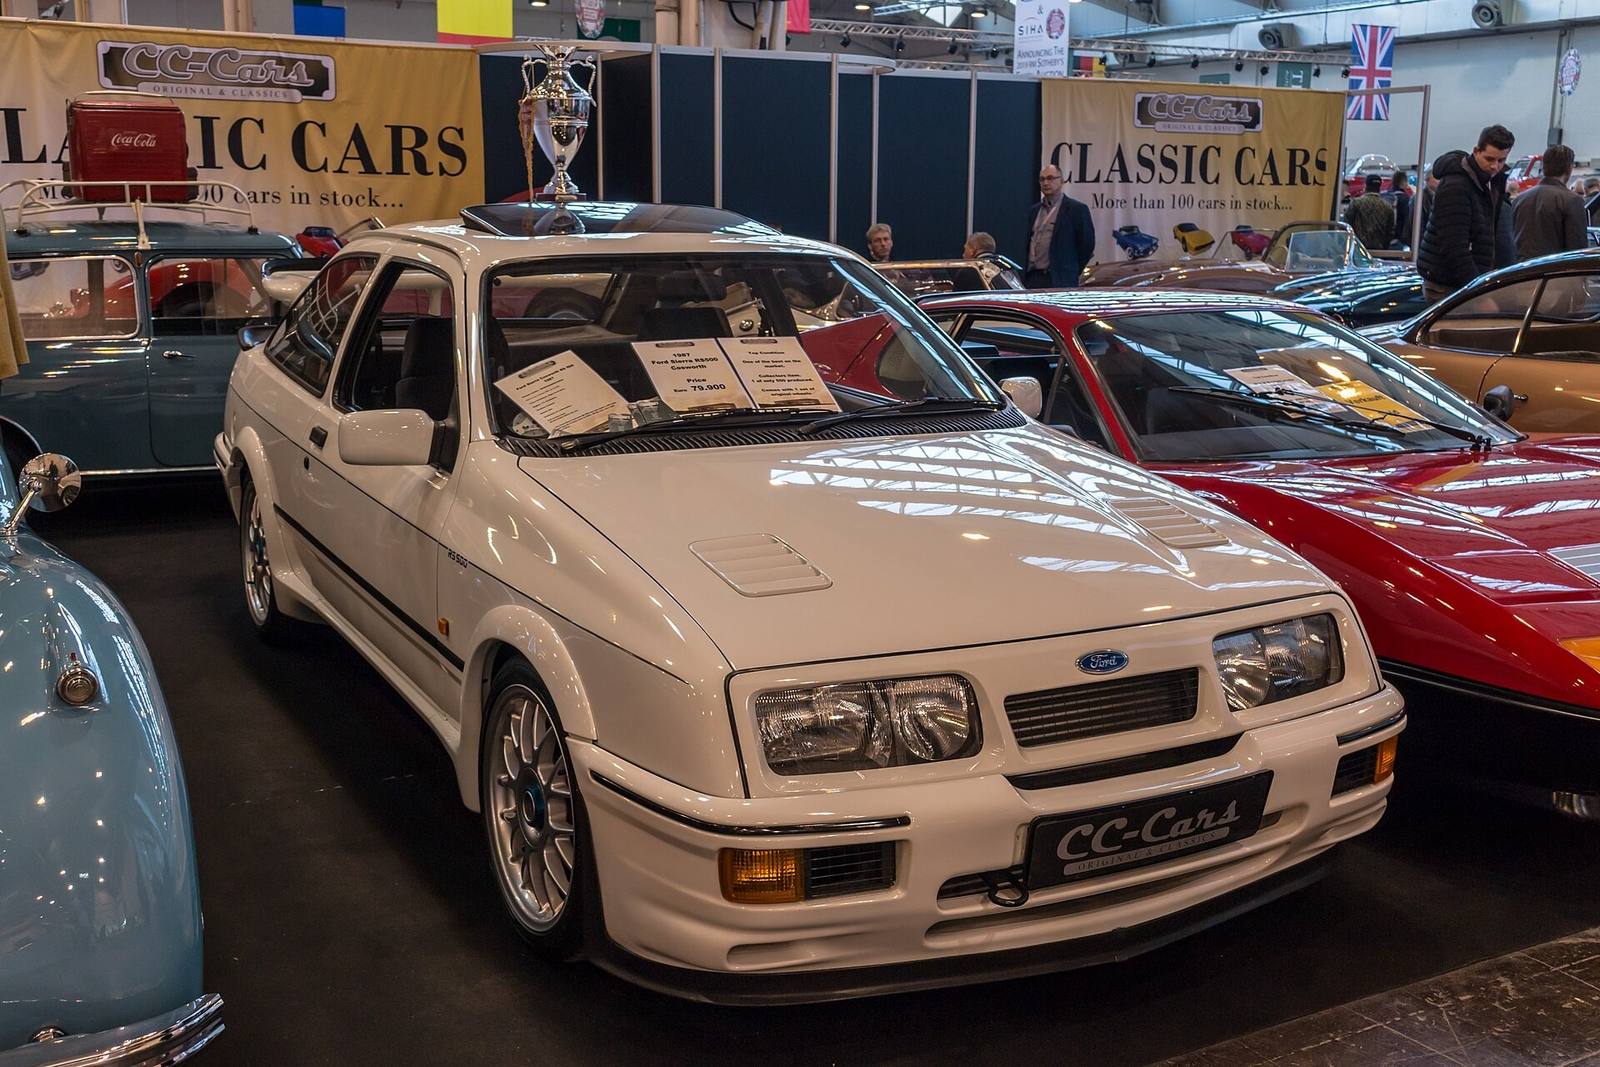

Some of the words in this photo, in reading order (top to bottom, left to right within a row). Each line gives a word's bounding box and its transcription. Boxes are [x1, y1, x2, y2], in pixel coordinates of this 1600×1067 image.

[1018, 25, 1043, 36] SIHA
[123, 42, 315, 87] CC-Cars
[153, 85, 212, 97] ORIGINAL
[218, 88, 227, 97] &
[231, 89, 288, 99] CLASSICS
[1148, 93, 1252, 122] CC-Cars
[291, 120, 468, 177] CARS
[1050, 142, 1221, 185] CLASSIC
[1235, 147, 1327, 187] CARS
[234, 189, 281, 204] cars
[291, 185, 310, 205] in
[320, 187, 404, 207] stock...
[1092, 193, 1125, 209] More
[1133, 194, 1165, 210] than
[1171, 194, 1194, 209] 100
[1198, 197, 1225, 210] cars
[1230, 194, 1242, 209] in
[690, 383, 726, 392] 79.900
[1090, 654, 1118, 669] Ford
[1056, 800, 1240, 860] CC-Cars
[1078, 850, 1140, 872] ORIGINAL
